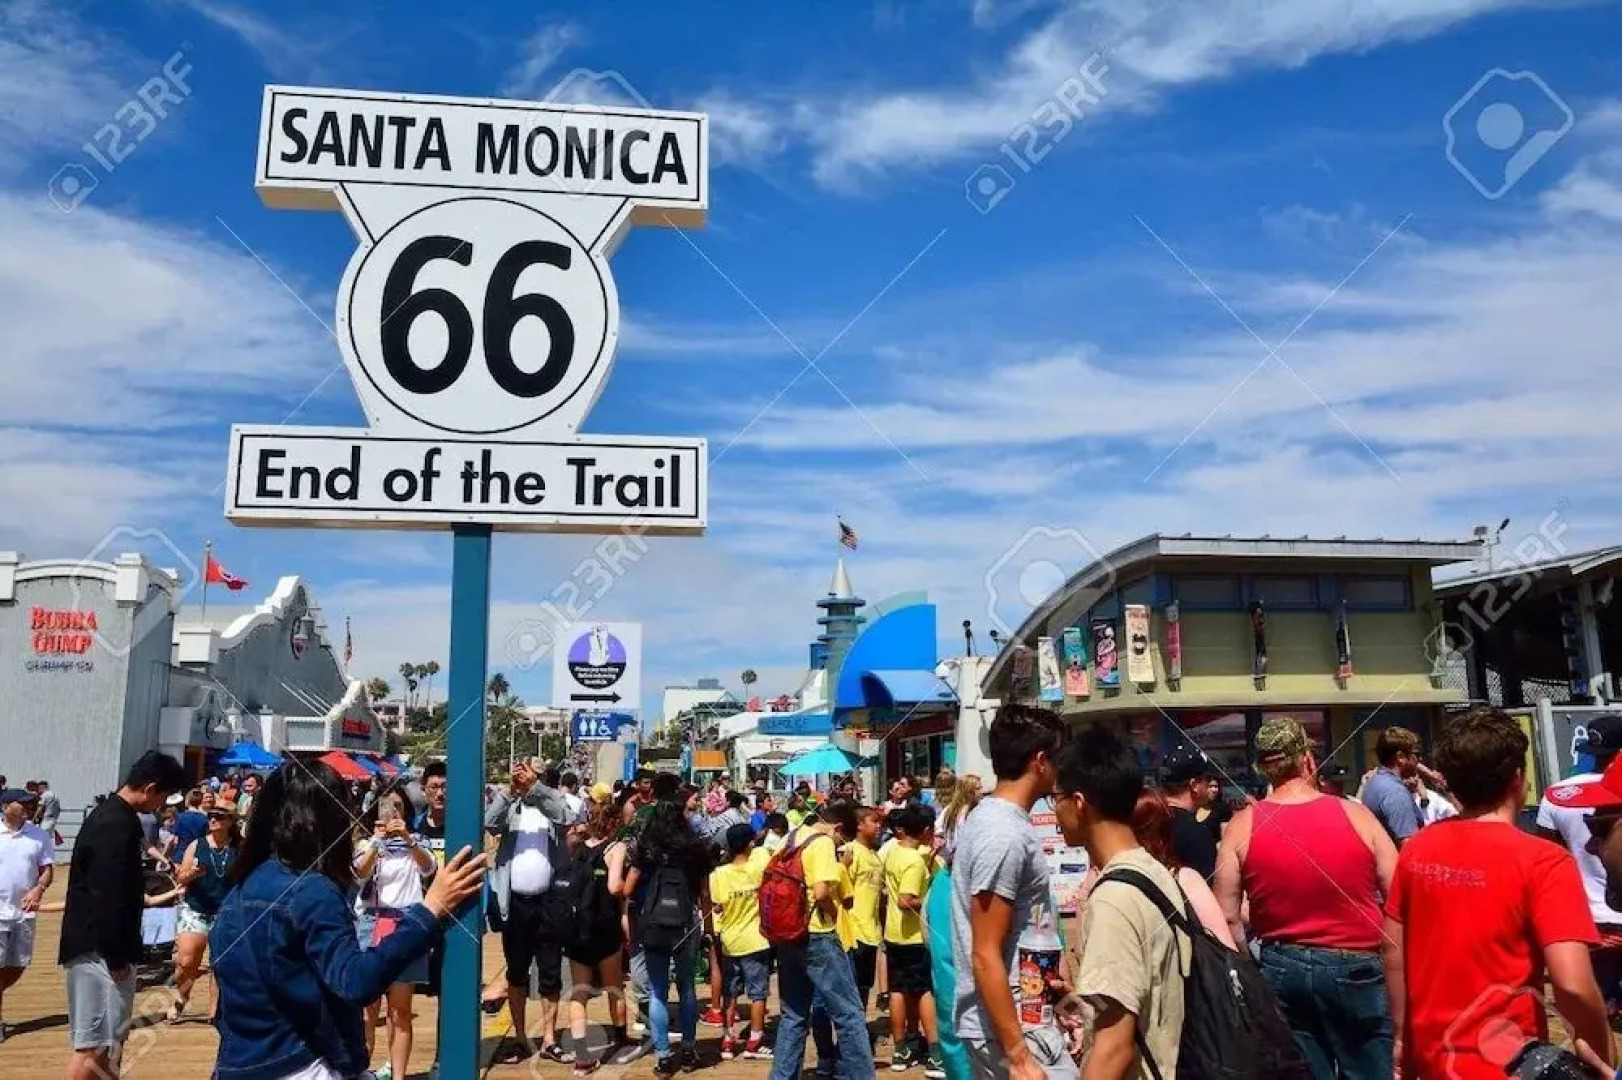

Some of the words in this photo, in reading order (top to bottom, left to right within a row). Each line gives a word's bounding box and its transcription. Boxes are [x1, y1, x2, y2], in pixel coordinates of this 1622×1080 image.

[281, 109, 451, 170] SANTA
[476, 123, 687, 184] MONICA
[381, 236, 574, 397] 66
[256, 446, 360, 500] End
[384, 448, 441, 501] of
[461, 449, 545, 504] the
[567, 455, 680, 507] Trail
[33, 633, 92, 654] GUMP
